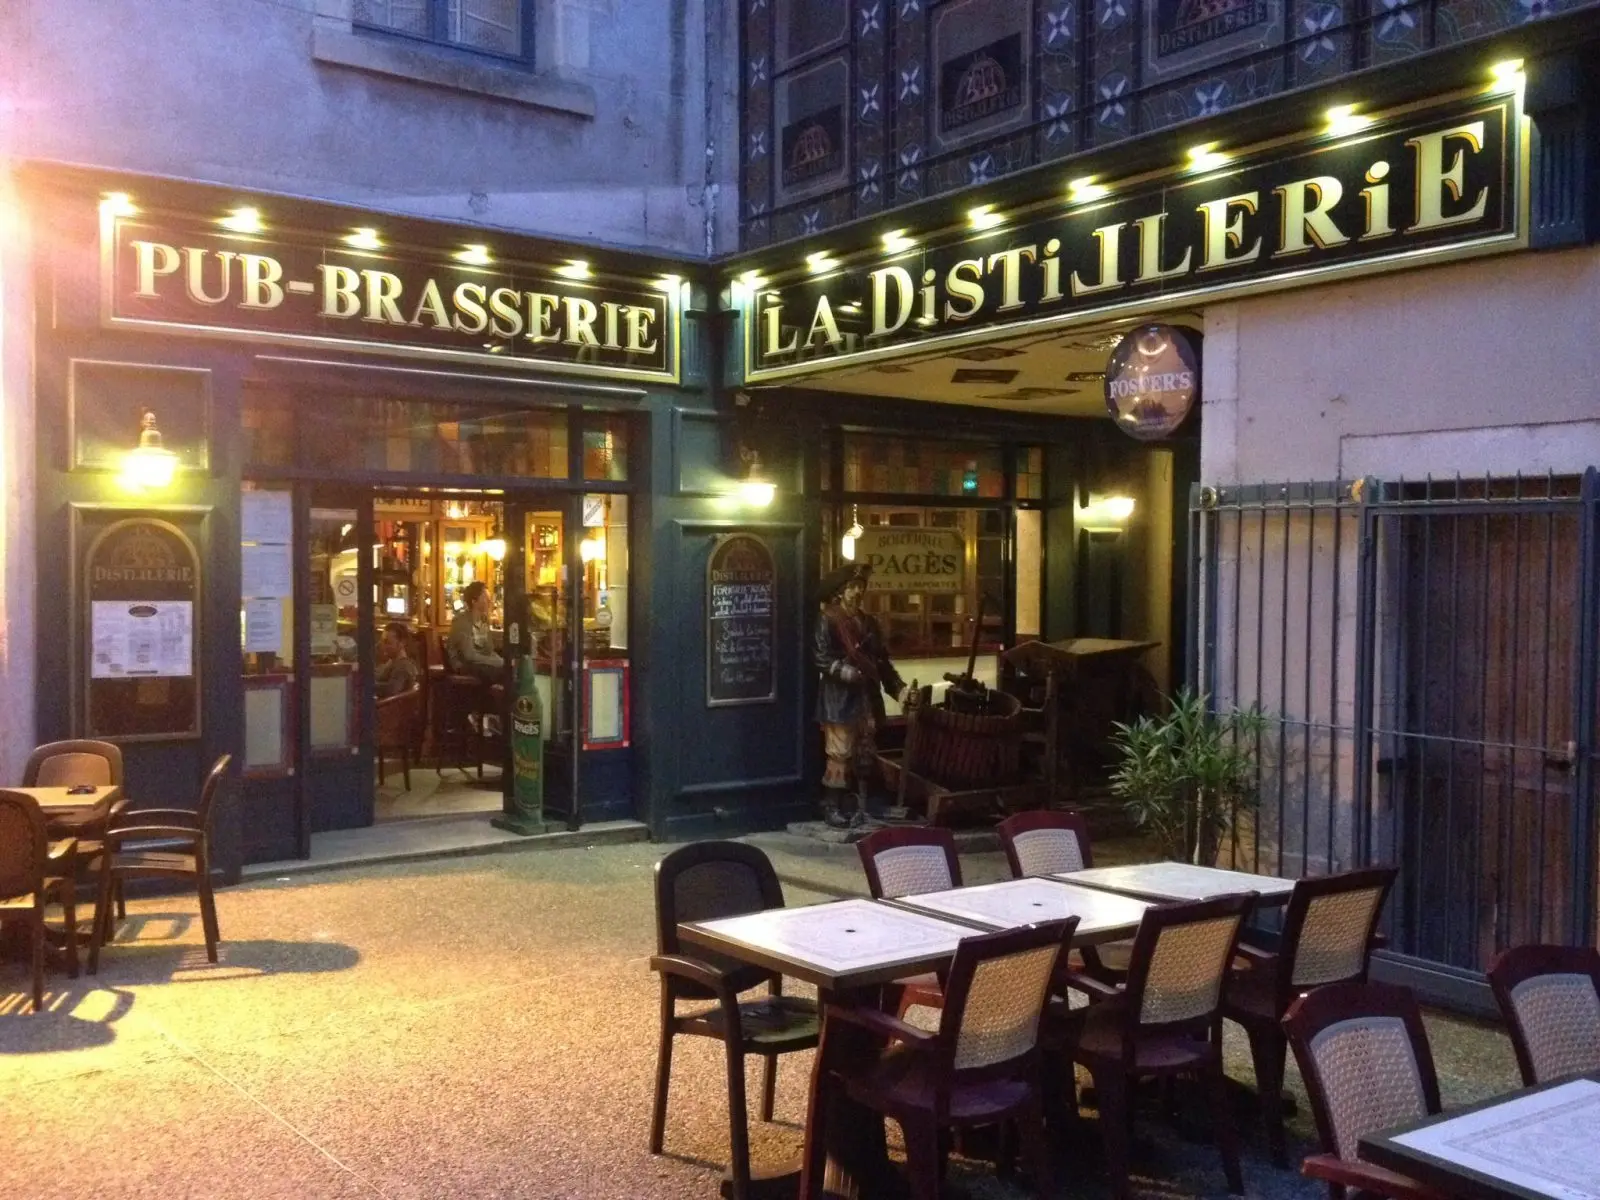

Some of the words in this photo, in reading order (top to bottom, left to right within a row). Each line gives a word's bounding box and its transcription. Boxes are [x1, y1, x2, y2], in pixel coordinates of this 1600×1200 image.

[132, 240, 658, 354] PUB-BRASSERIE
[762, 294, 843, 358] LA
[1109, 371, 1193, 399] FOSTER'S
[865, 550, 957, 575] PAGÈS
